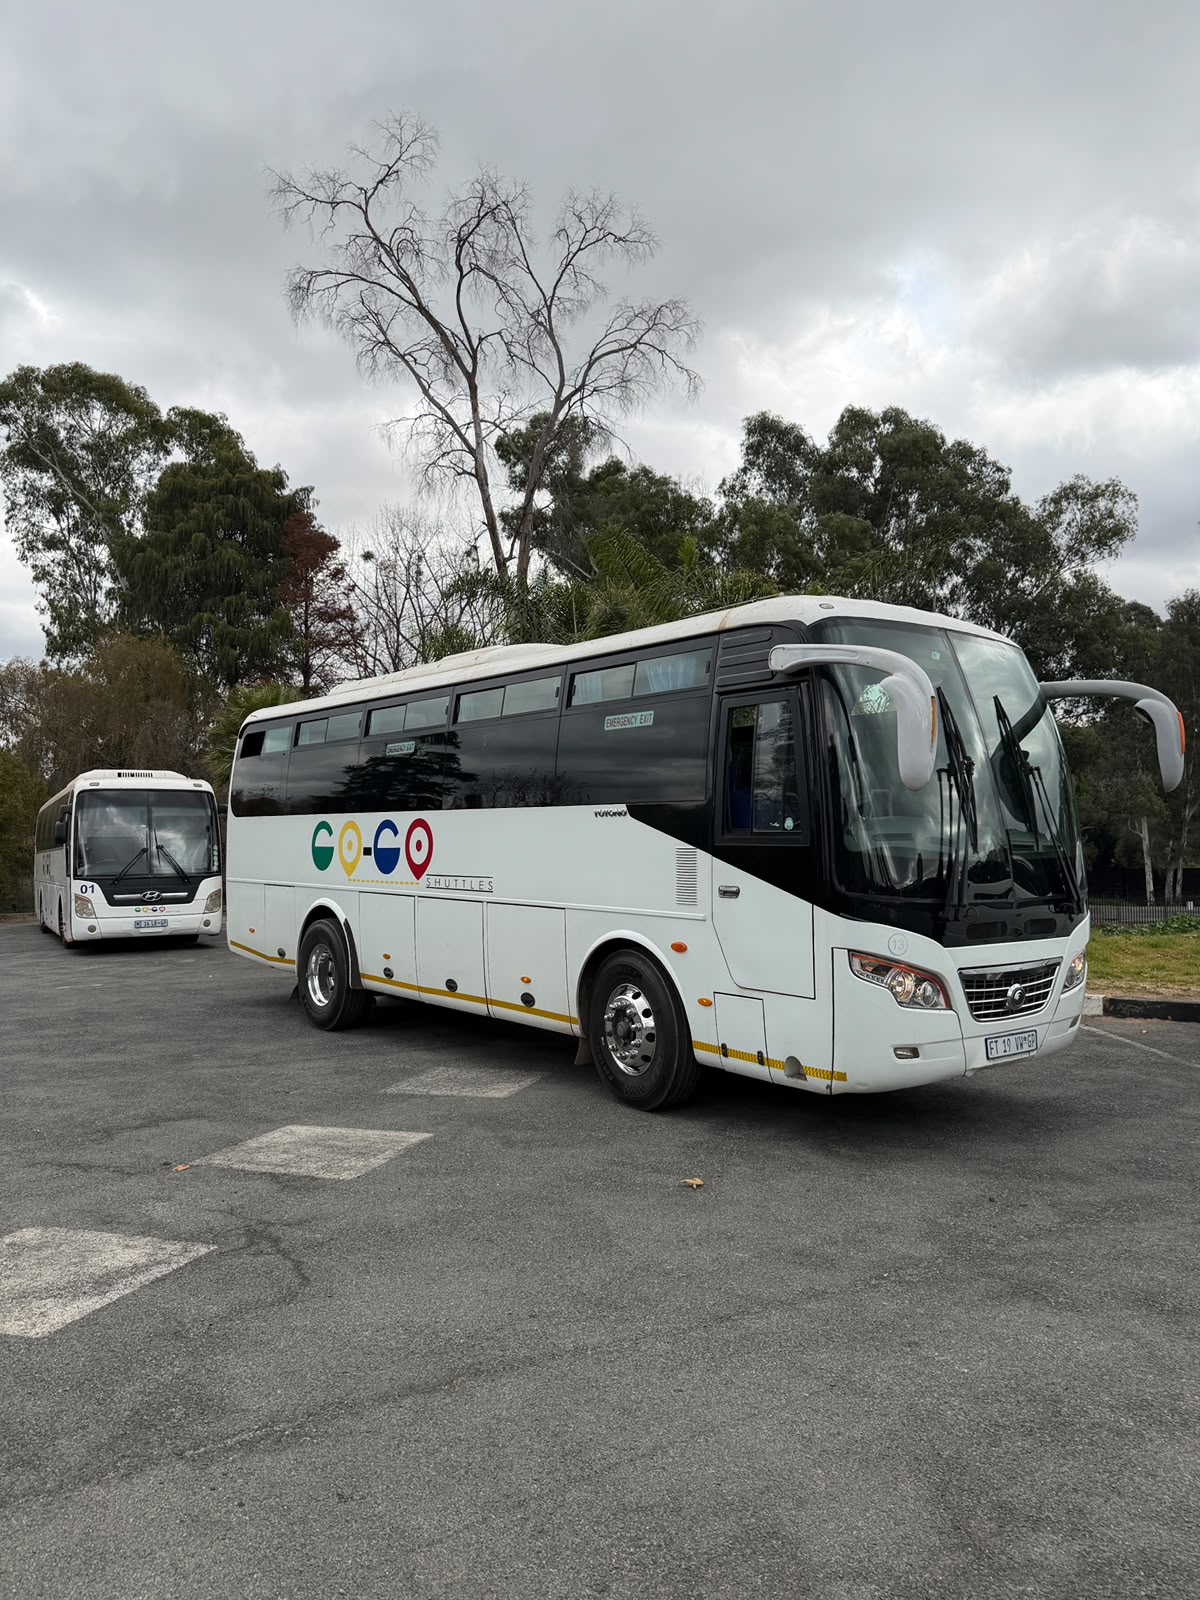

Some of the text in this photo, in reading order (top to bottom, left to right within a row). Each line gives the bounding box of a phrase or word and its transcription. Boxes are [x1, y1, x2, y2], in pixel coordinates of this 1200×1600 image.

[606, 712, 653, 728] EMERGENCY EXIT
[80, 884, 95, 894] 01
[426, 876, 494, 891] SHUTTLES
[989, 1039, 999, 1056] FT
[1002, 1038, 1012, 1053] 19
